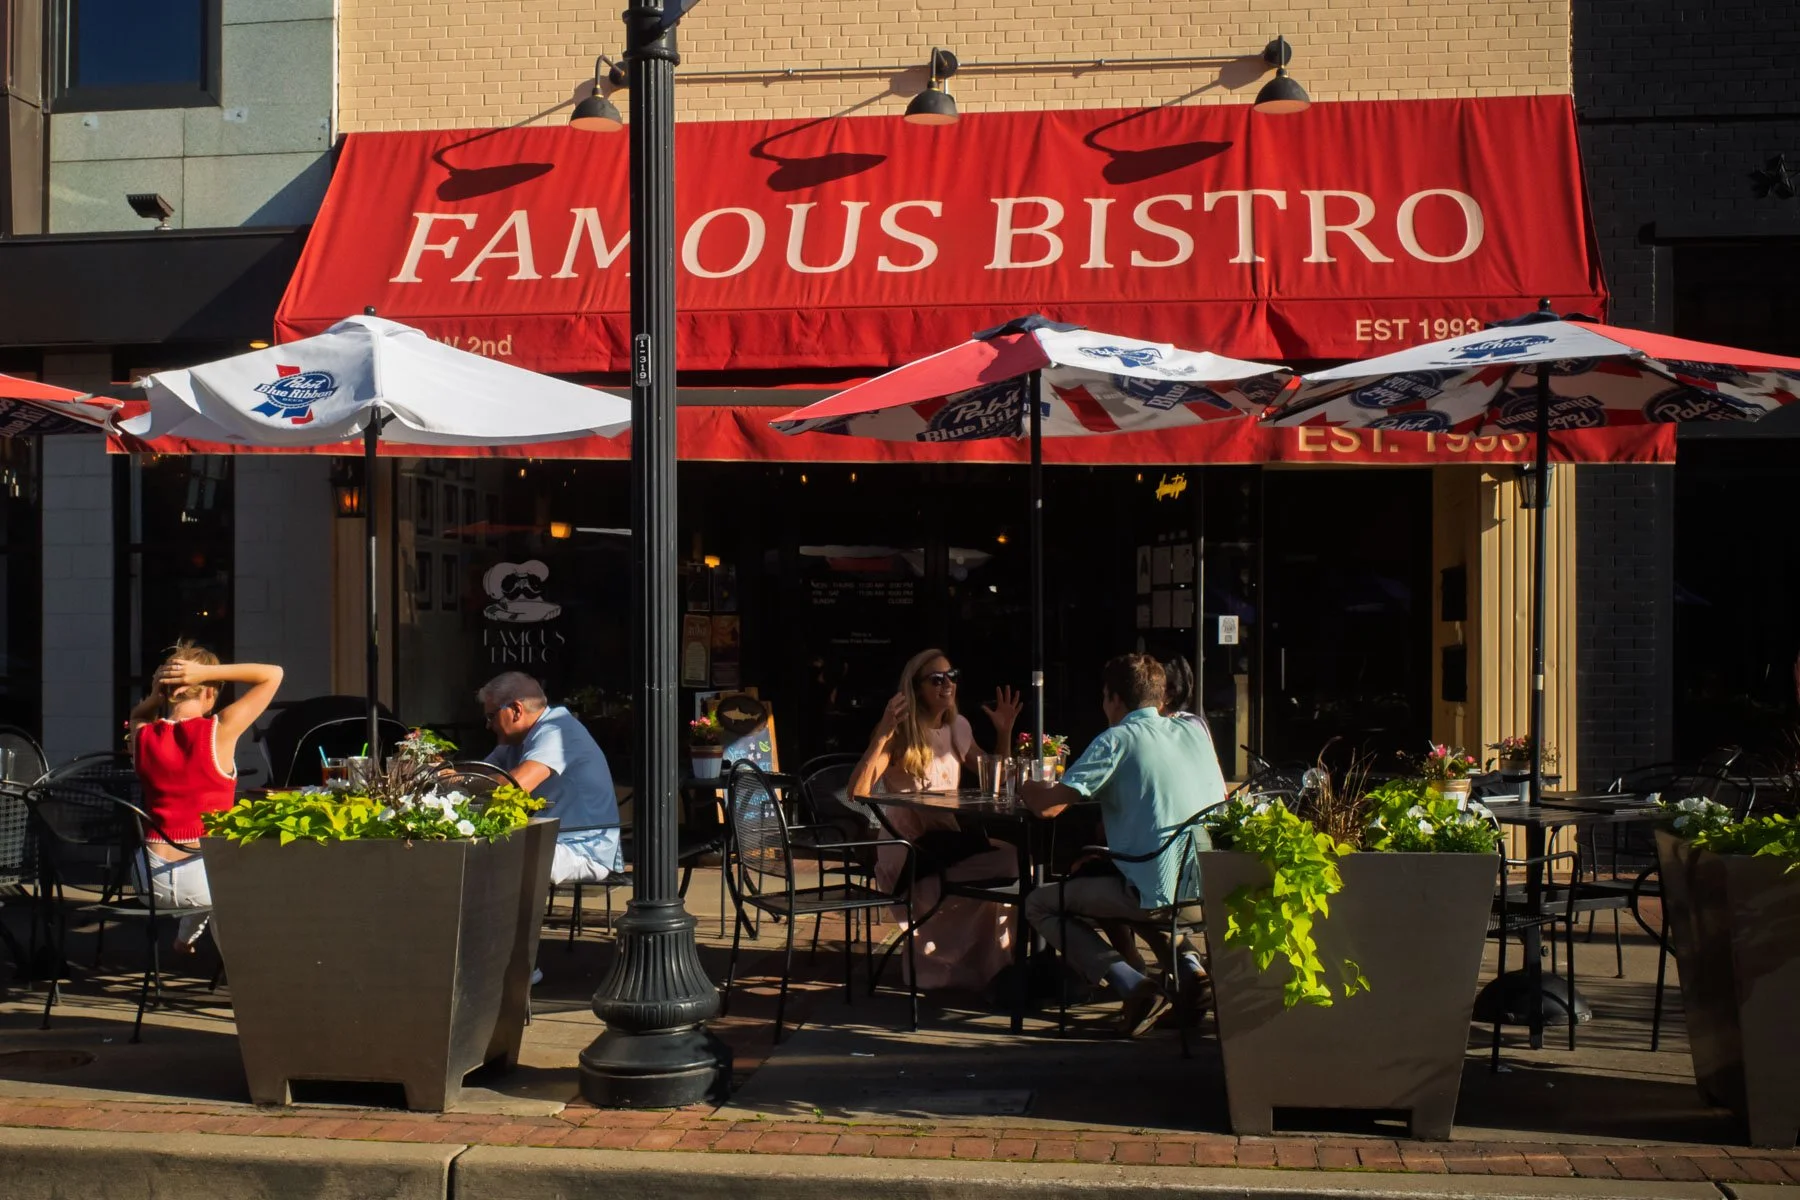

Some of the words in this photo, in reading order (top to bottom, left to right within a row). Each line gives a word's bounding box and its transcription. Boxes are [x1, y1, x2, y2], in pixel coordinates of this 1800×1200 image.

[388, 199, 943, 284] FAMOUS
[983, 187, 1485, 271] BISTRO
[1355, 318, 1411, 341] EST
[1418, 317, 1482, 340] 1993
[467, 334, 513, 356] 2nd
[257, 383, 288, 397] Blue
[288, 388, 334, 400] Ribbon
[283, 376, 326, 389] Pabst
[949, 387, 1021, 424] Pabst
[1146, 383, 1191, 409] Blue
[923, 425, 977, 442] Blue
